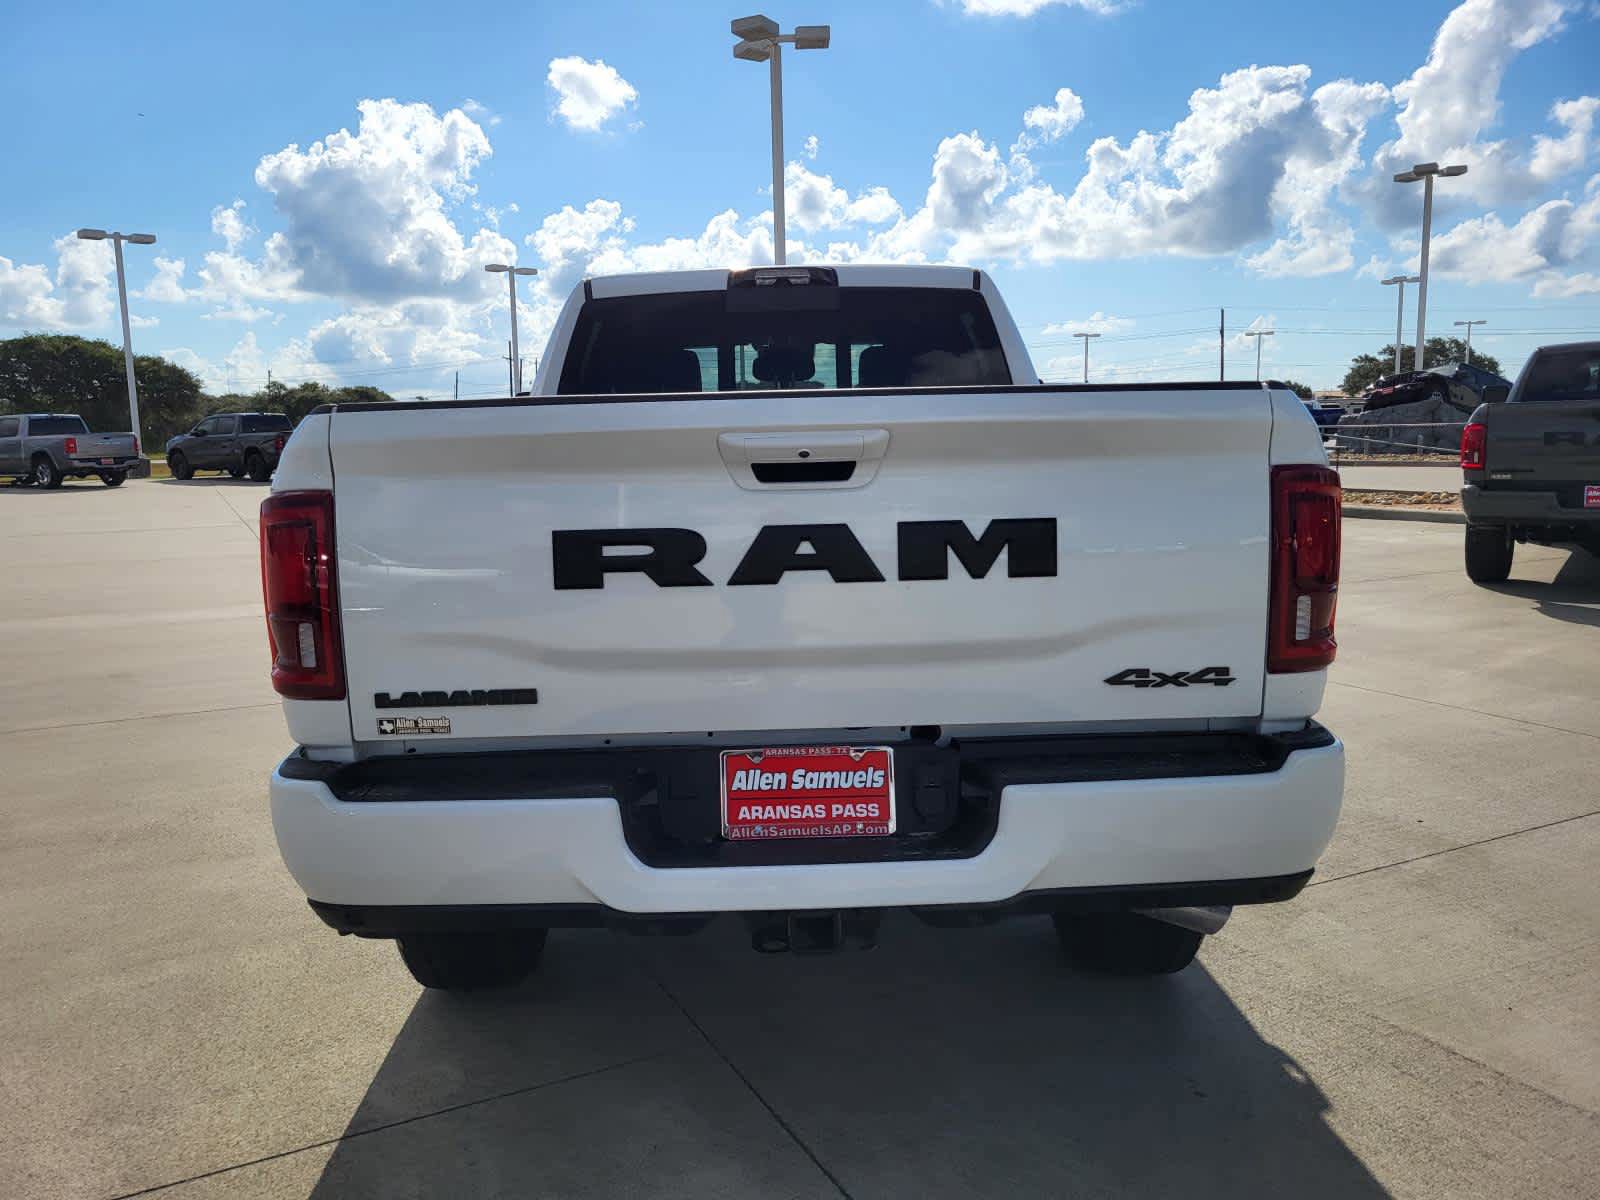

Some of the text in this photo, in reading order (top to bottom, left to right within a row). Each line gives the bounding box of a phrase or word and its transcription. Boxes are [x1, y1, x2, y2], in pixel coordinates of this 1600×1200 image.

[552, 517, 1058, 590] RAM
[1103, 666, 1237, 688] 4x4
[765, 748, 807, 756] ARANSAS
[731, 766, 885, 790] Allen Samuels
[738, 803, 880, 820] ARANSAS PASS
